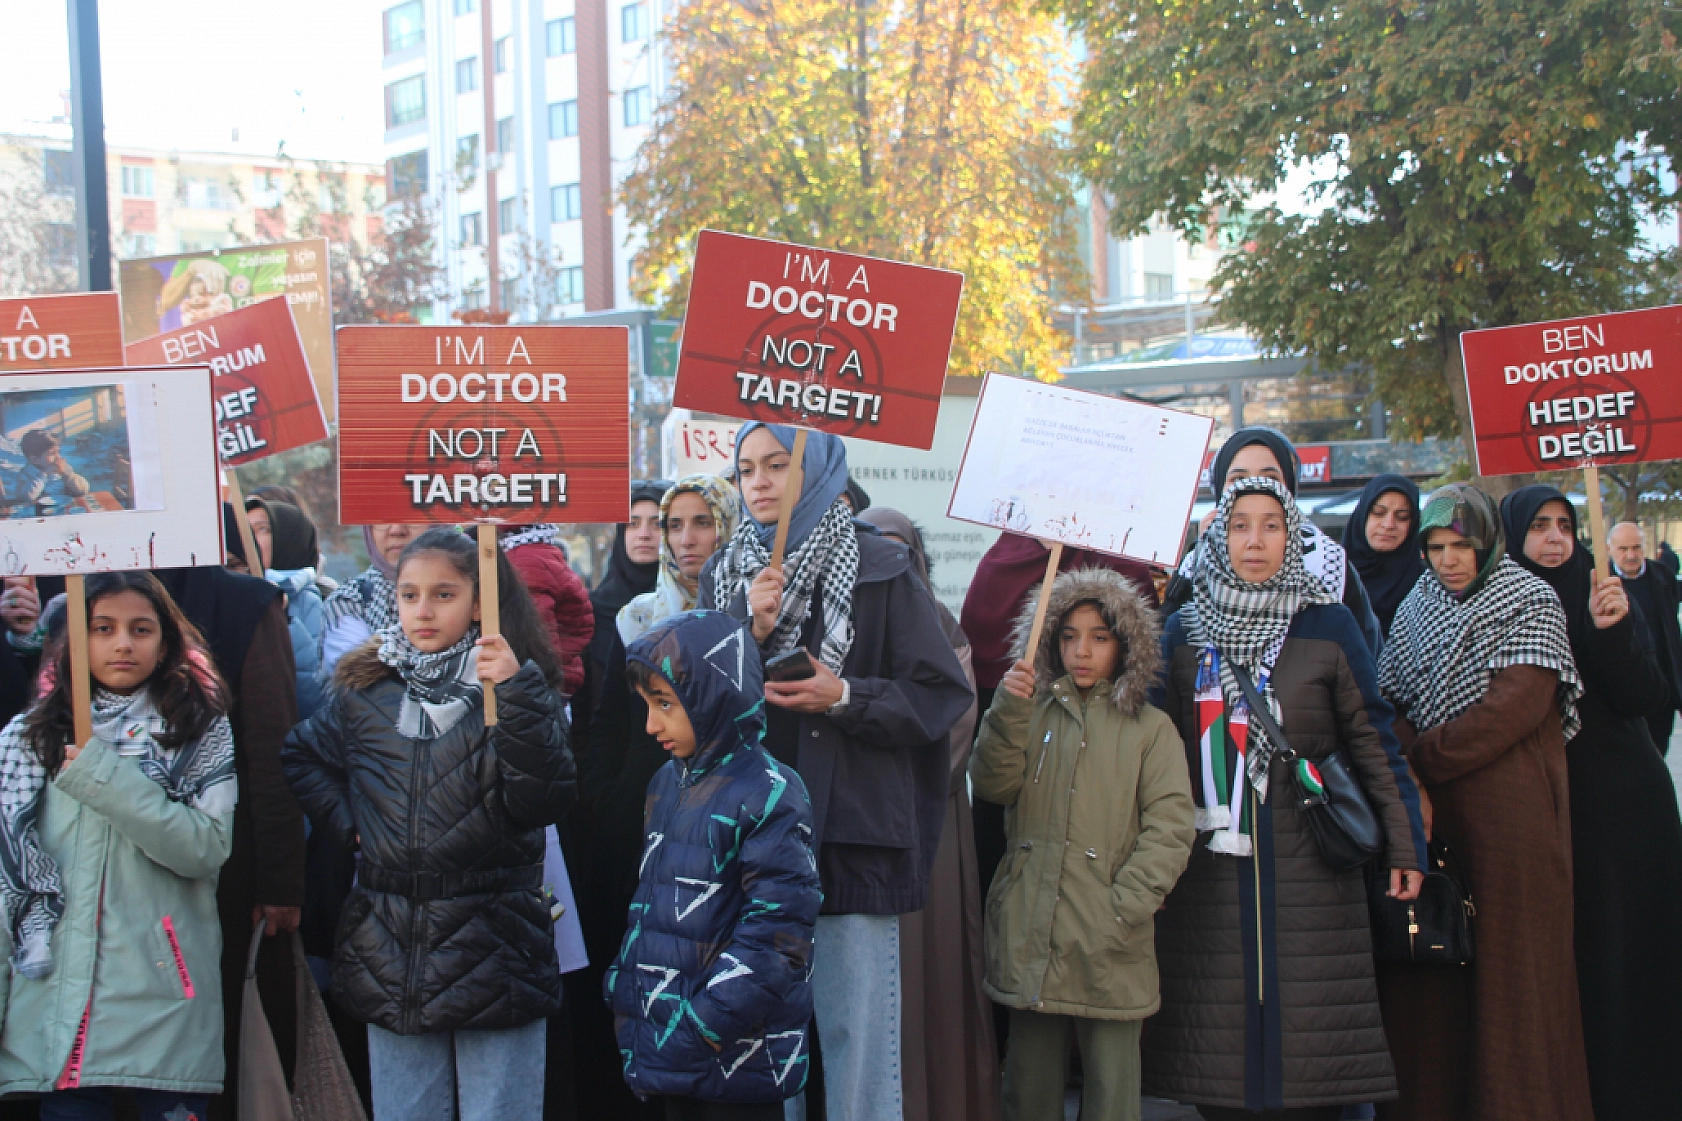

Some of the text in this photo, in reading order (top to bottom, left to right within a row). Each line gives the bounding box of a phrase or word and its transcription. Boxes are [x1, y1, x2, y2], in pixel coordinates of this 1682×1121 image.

[783, 252, 871, 293] I'M A
[16, 304, 40, 331] A
[746, 281, 899, 332] DOCTOR
[0, 333, 72, 362] TOR
[162, 325, 220, 364] BEN
[436, 336, 532, 366] I'M A
[1542, 323, 1605, 354] BEN
[762, 334, 864, 378] NOT A
[1504, 349, 1654, 385] DOKTORUM
[401, 373, 568, 403] DOCTOR
[736, 372, 882, 421] TARGET!
[1529, 391, 1636, 426] HEDEF
[429, 428, 542, 458] NOT A
[1538, 423, 1637, 460] DEĞİL
[405, 473, 568, 503] TARGET!
[903, 466, 957, 482] TÜRKÜS
